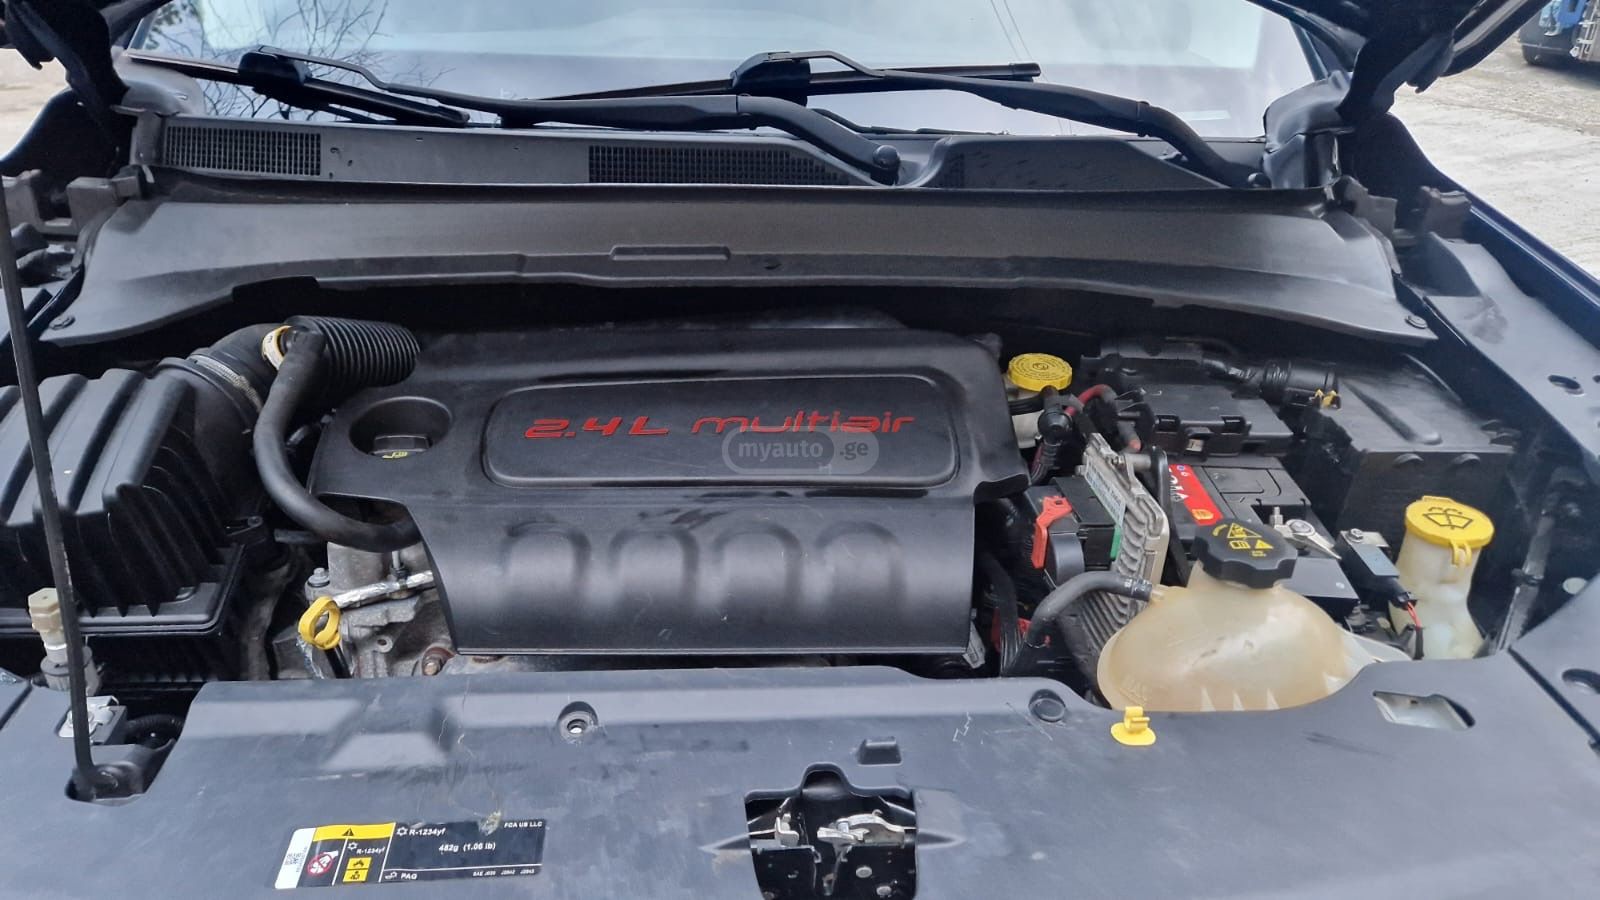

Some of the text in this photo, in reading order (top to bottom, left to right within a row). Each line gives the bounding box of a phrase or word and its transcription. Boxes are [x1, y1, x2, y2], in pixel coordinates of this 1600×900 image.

[691, 411, 915, 433] multiair
[409, 828, 446, 837] R-1234yf
[400, 872, 418, 880] PAG
